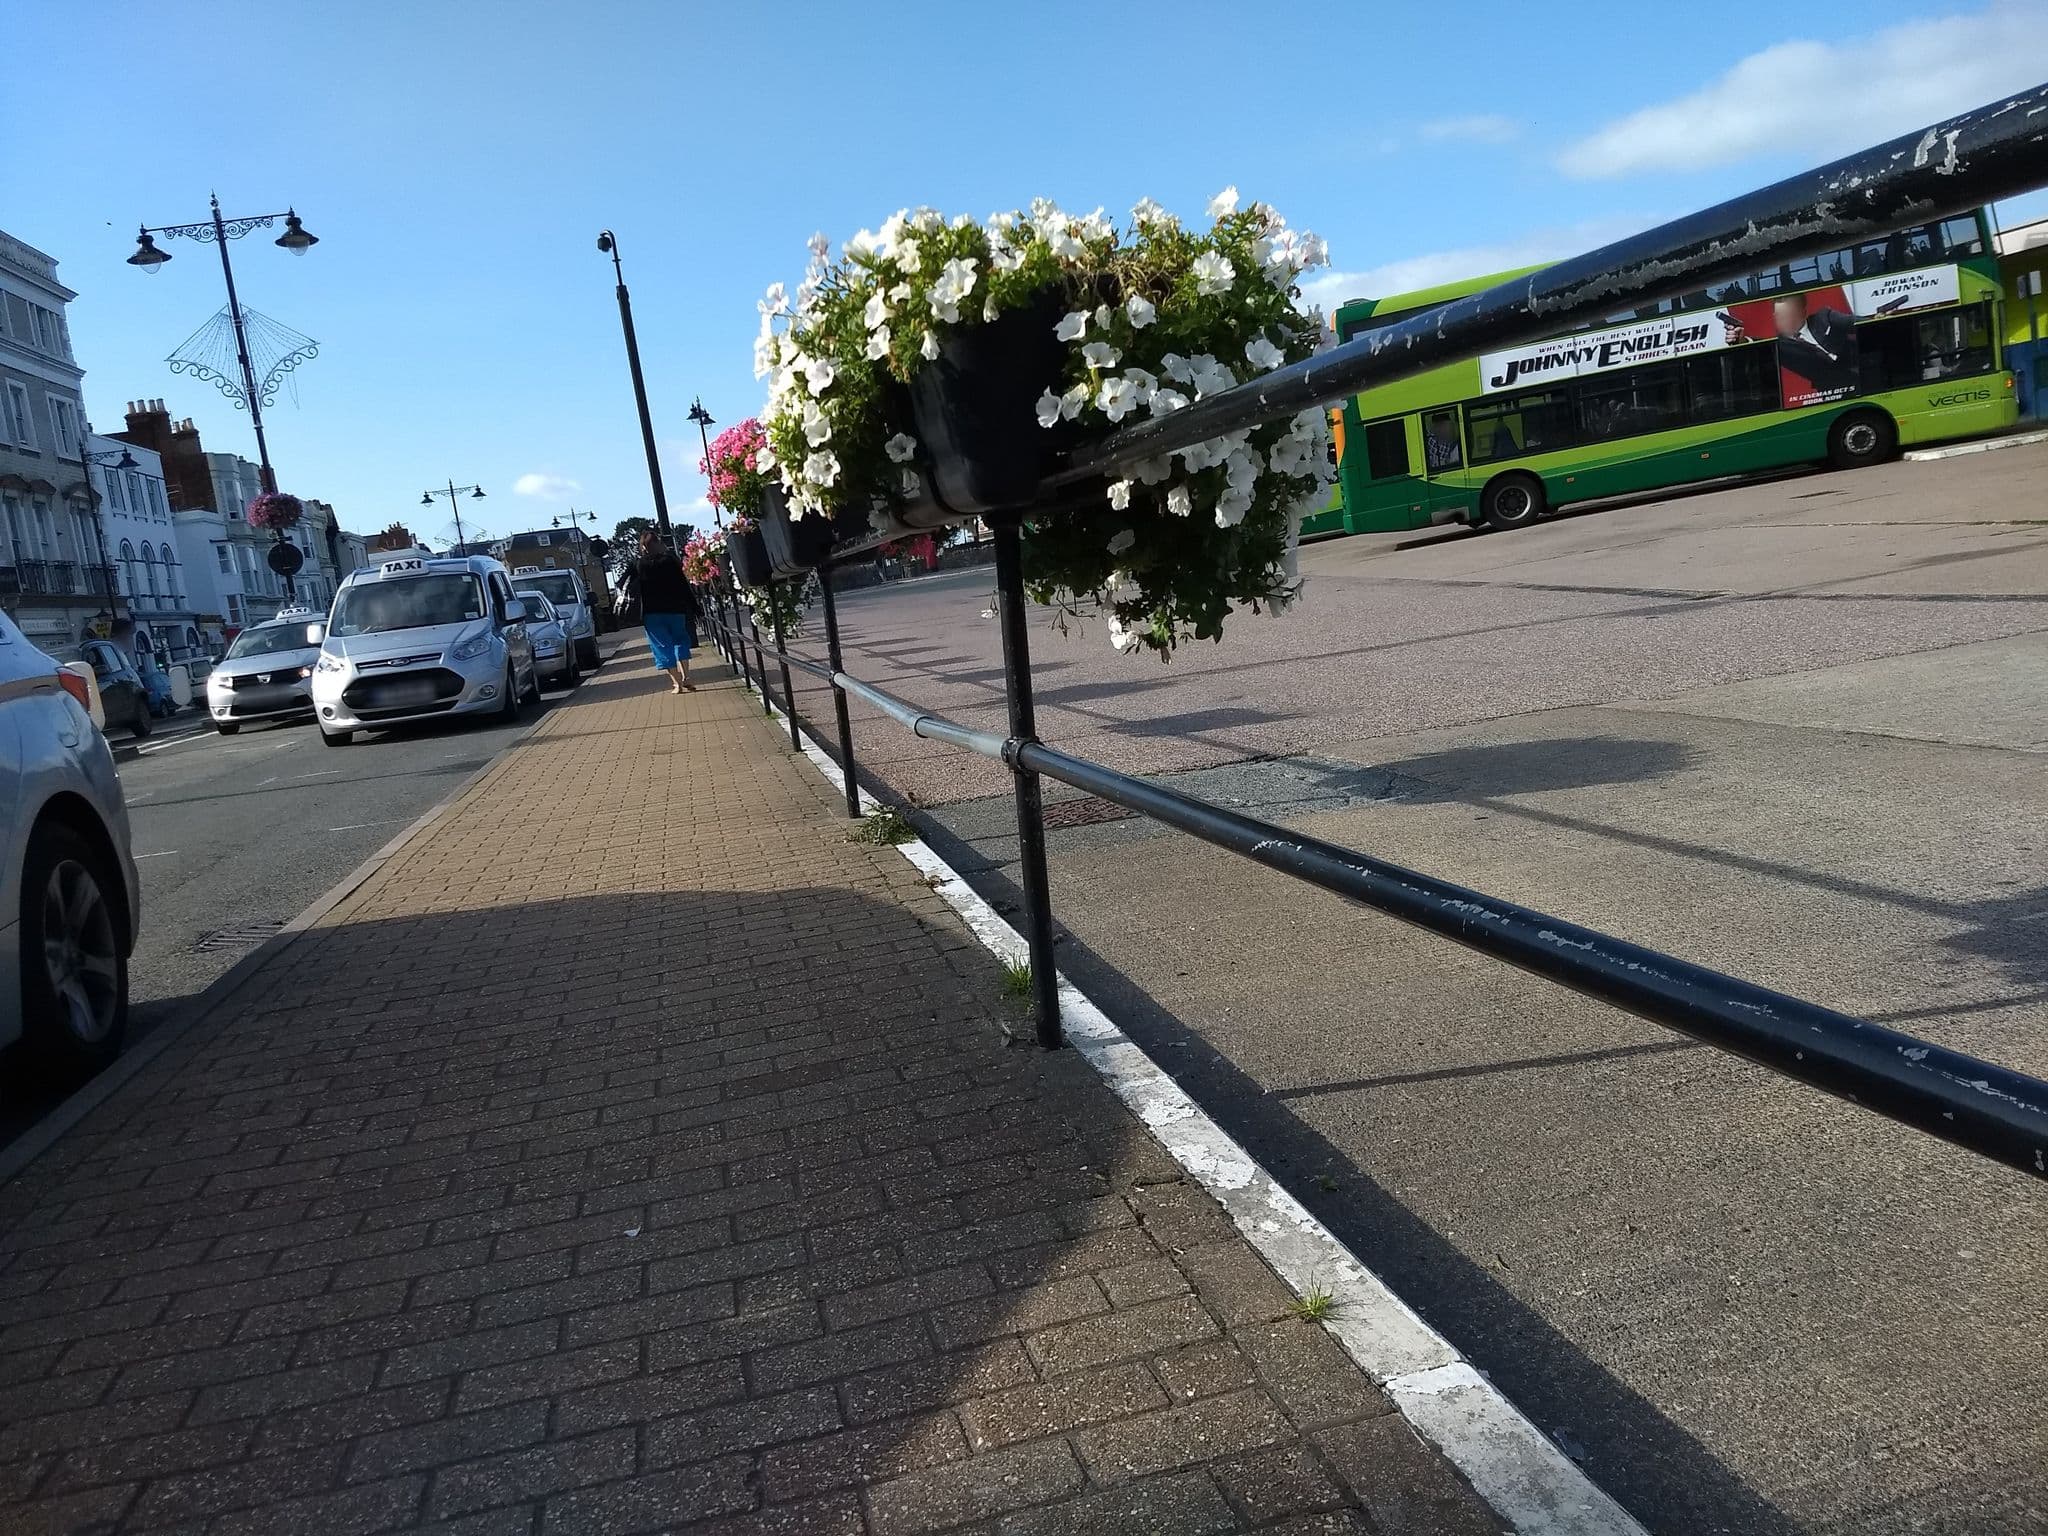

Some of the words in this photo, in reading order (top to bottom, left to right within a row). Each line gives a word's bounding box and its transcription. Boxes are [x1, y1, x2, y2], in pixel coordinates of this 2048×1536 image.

[1884, 274, 1924, 287] ROWAN
[1871, 279, 1939, 297] ATKINSON
[1539, 344, 1563, 353] WHEN
[1567, 340, 1586, 349] ONLY
[1611, 331, 1632, 340] BEST
[1636, 326, 1655, 334] WILL
[1491, 345, 1598, 388] JOHNNY
[1598, 324, 1709, 367] ENGLISH
[1625, 349, 1669, 362] STRIKES
[1673, 341, 1707, 354] AGAIN
[1799, 389, 1833, 401] CINEMAS
[1802, 397, 1824, 405] BOOK
[1824, 394, 1843, 402] NOW
[1928, 389, 1991, 407] VECTIS
[385, 560, 422, 573] TAXI
[517, 566, 537, 574] TAXI
[281, 607, 308, 615] TAXI
